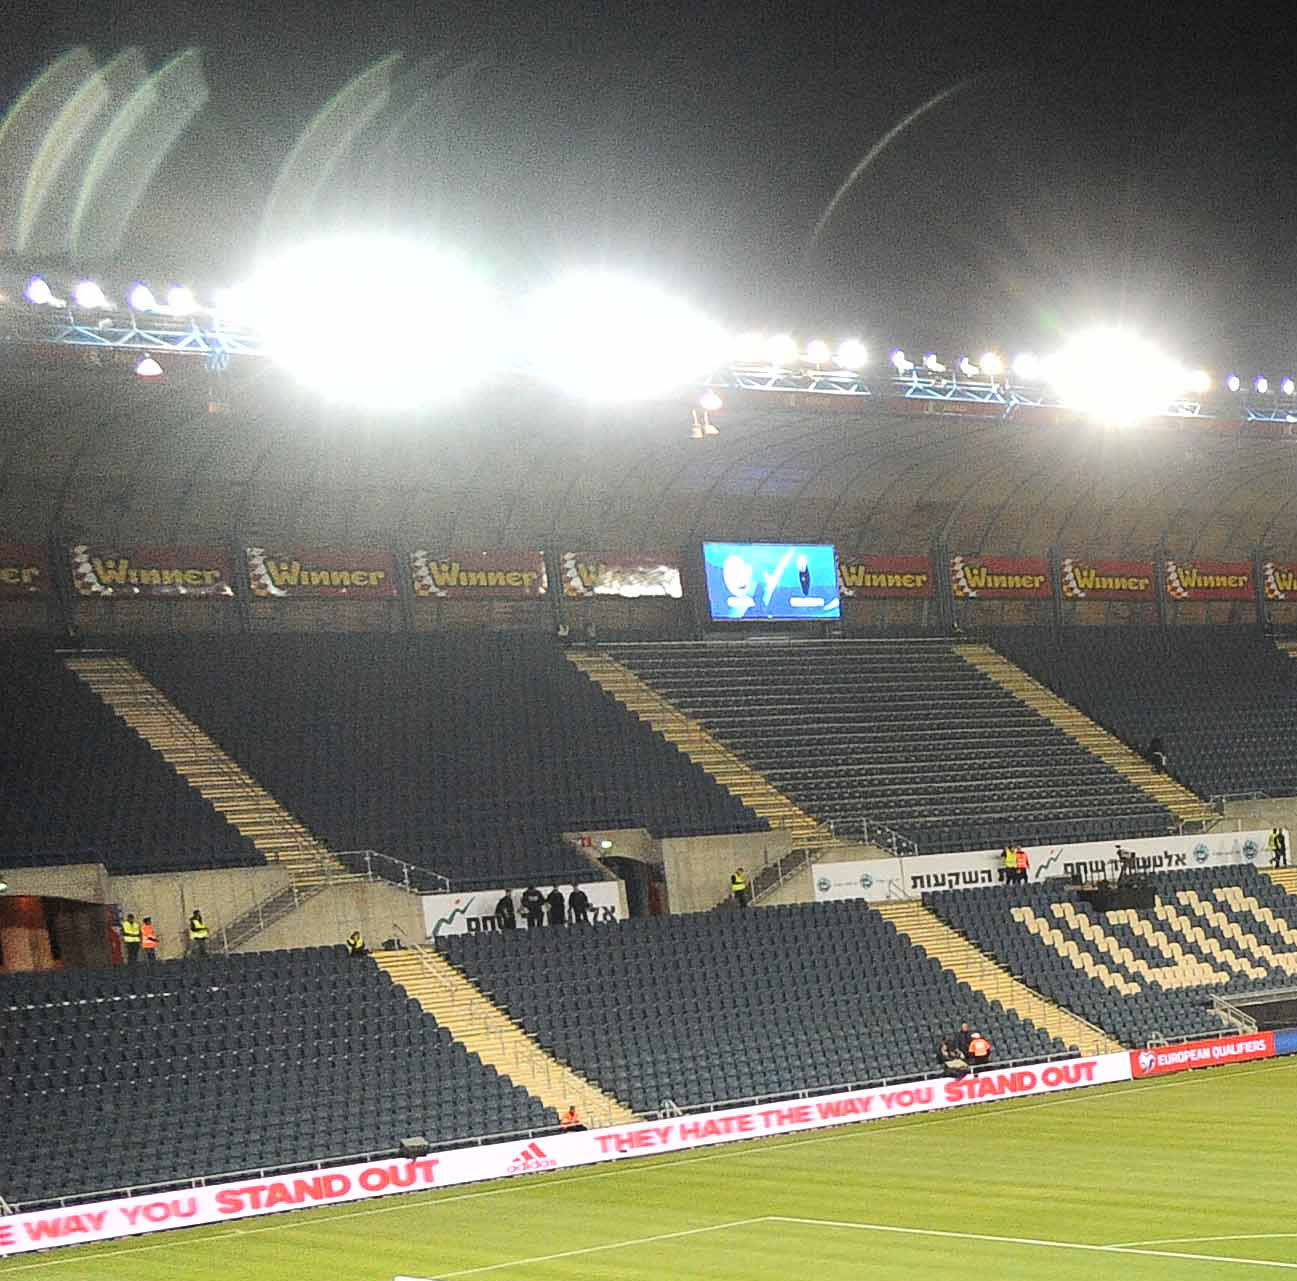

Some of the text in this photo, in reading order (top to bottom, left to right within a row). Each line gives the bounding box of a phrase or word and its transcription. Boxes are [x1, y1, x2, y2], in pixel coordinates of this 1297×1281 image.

[95, 558, 219, 585] Winner
[266, 559, 384, 586] Winner
[430, 561, 537, 587] Winner
[840, 566, 928, 587] Winner
[963, 567, 1045, 589] Winner
[1073, 568, 1149, 591] Winner
[1178, 568, 1248, 589] Winner
[1157, 1040, 1267, 1066] EUROPEAN QUALIFIERS
[594, 1061, 1098, 1153] THEY HATE THE WAY YOU STAND OUT
[507, 1158, 557, 1173] adidas
[24, 1210, 107, 1242] WAY
[120, 1197, 199, 1224] YOU
[217, 1174, 351, 1214] STAND
[359, 1159, 440, 1192] OUT
